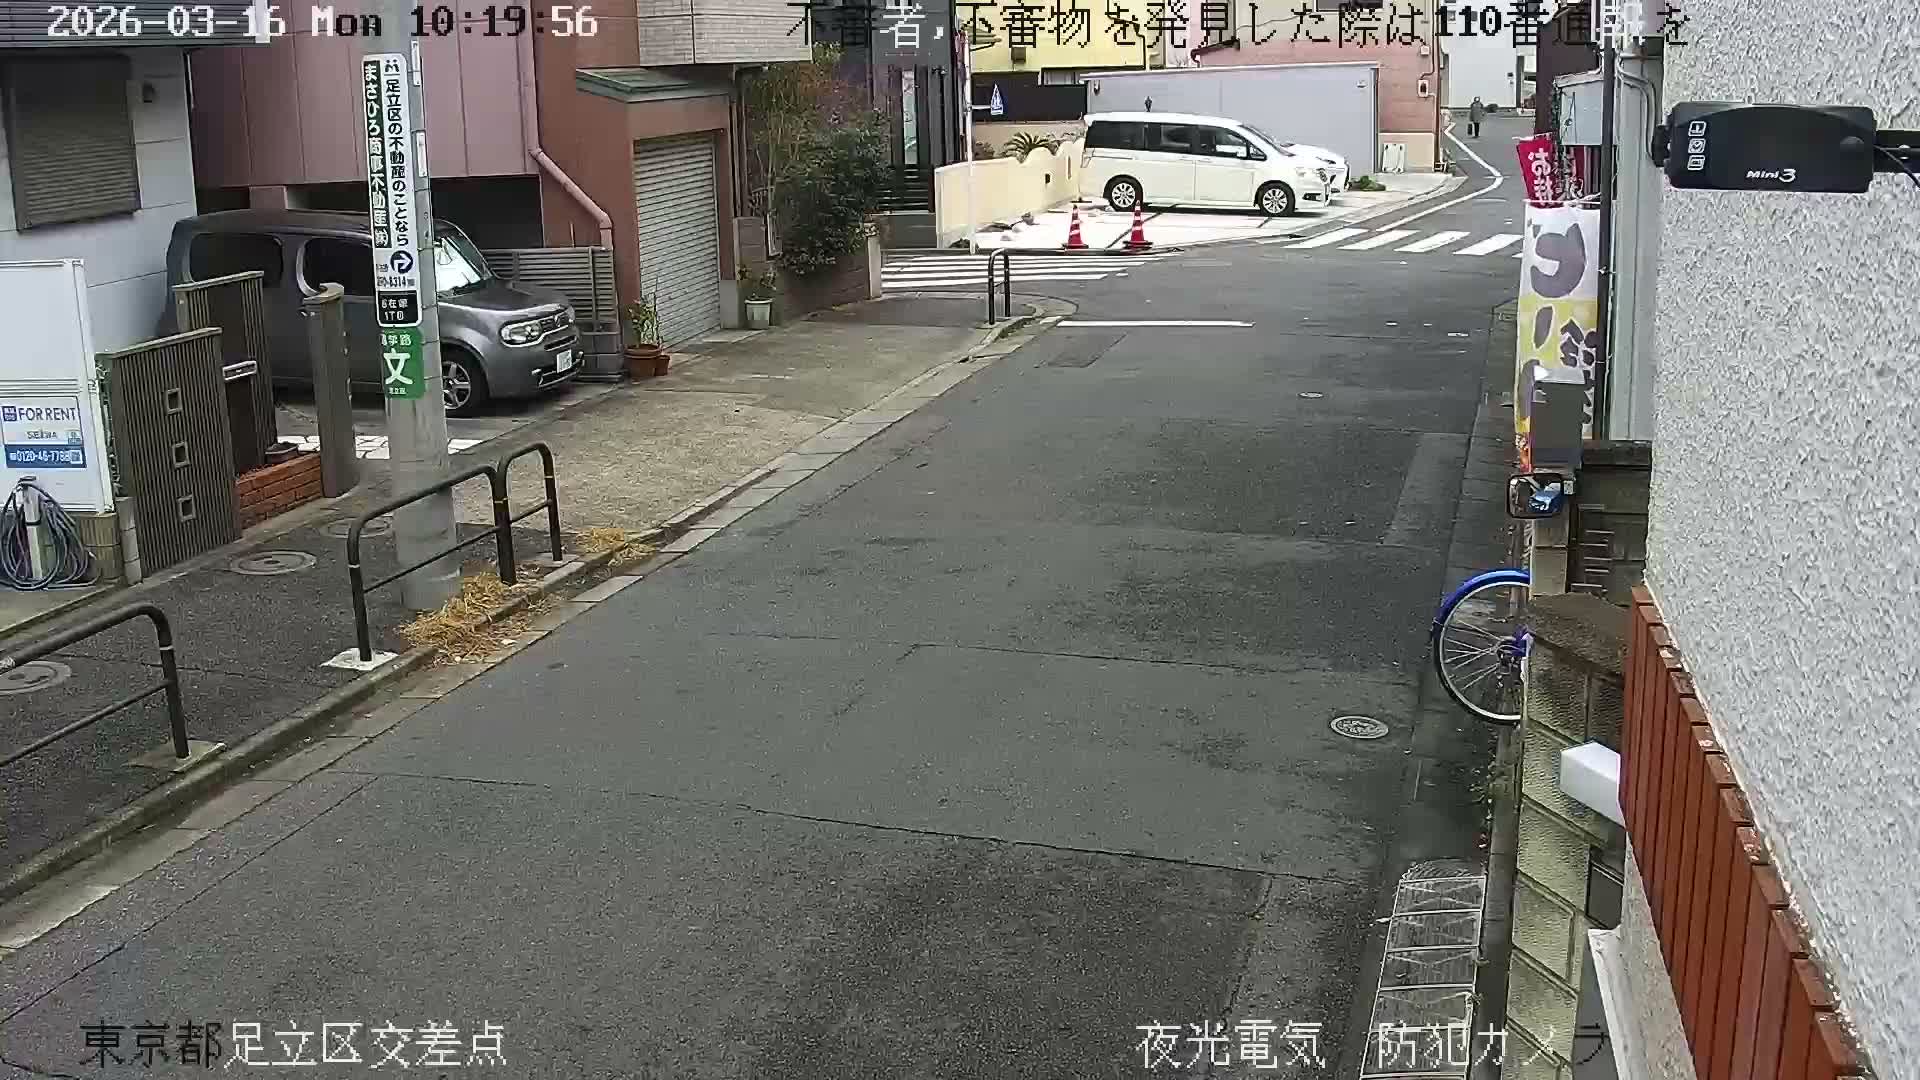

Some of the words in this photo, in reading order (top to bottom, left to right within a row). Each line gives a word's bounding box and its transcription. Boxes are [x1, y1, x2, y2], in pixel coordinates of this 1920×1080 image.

[383, 348, 413, 385] 文
[18, 407, 43, 421] FOR
[45, 407, 76, 421] RENT
